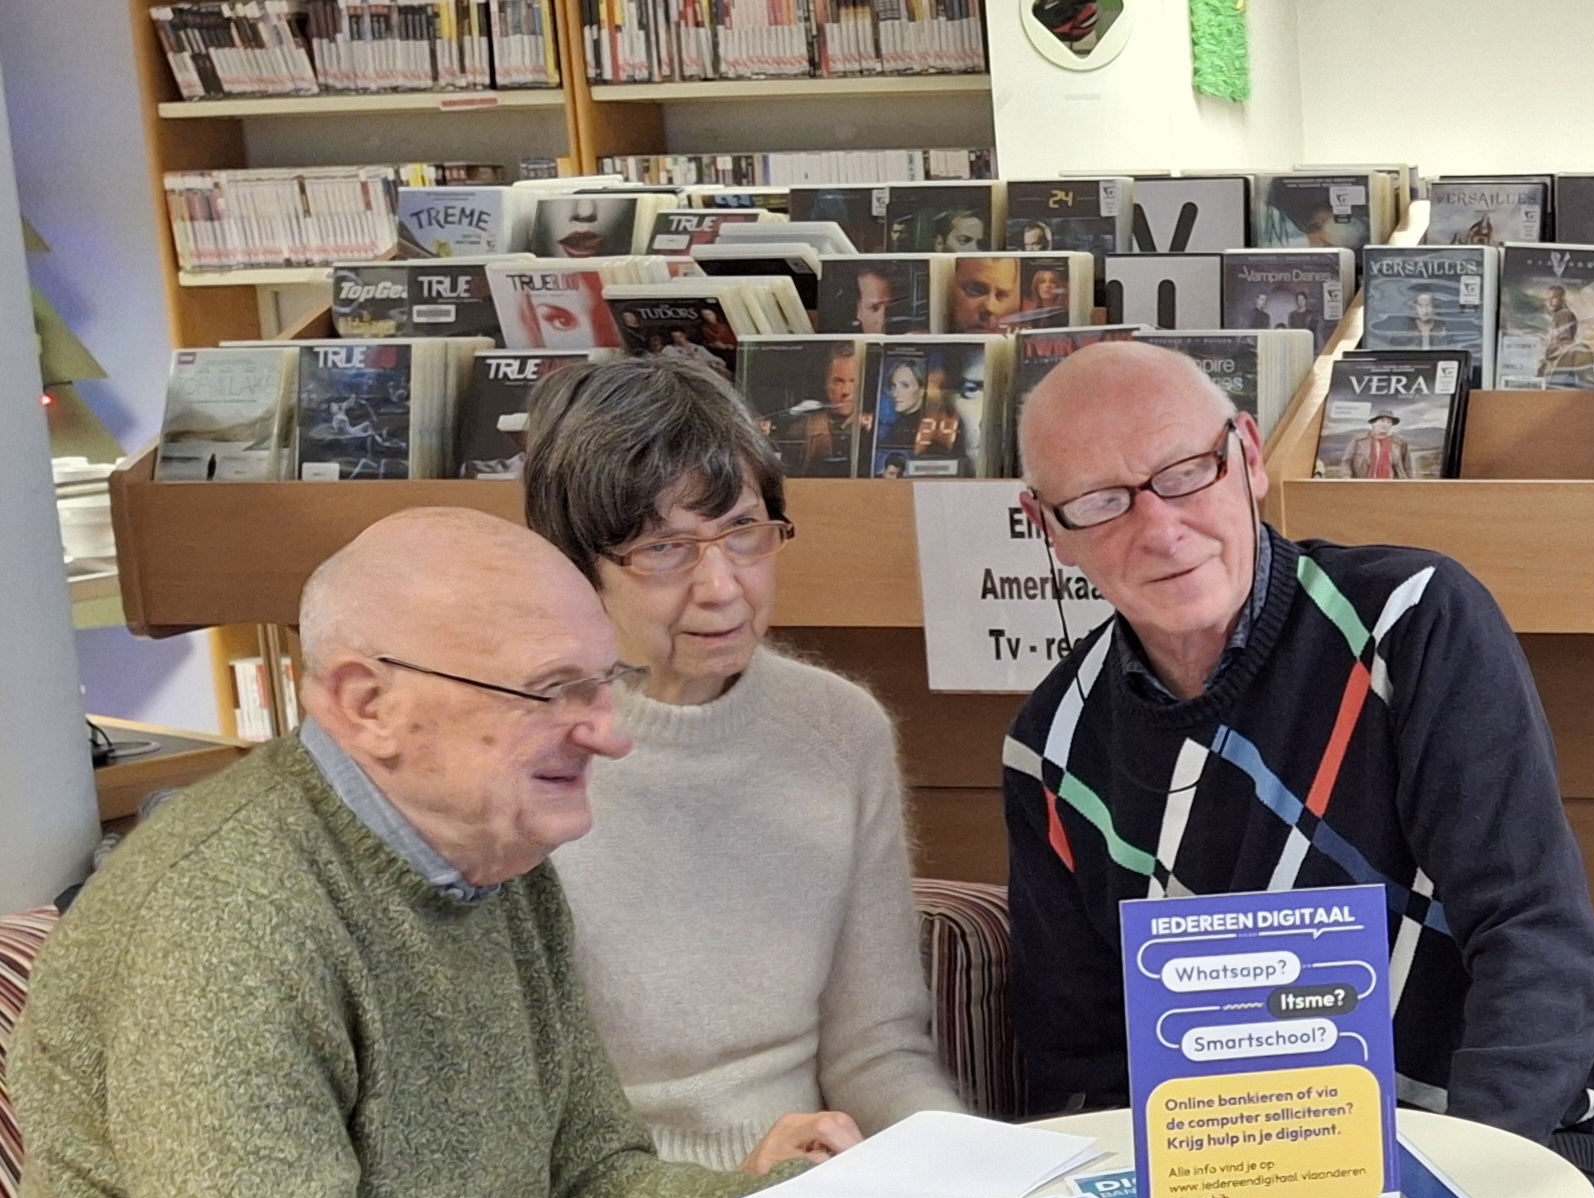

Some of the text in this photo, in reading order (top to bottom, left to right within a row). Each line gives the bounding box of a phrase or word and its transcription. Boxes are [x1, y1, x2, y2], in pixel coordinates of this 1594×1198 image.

[1049, 190, 1073, 208] 24
[409, 205, 491, 232] TREME
[669, 215, 718, 232] TRUE
[1370, 260, 1479, 279] VERSAILLES
[417, 275, 472, 298] TRUE
[505, 273, 551, 291] TRUE
[637, 307, 699, 320] TUDORS
[313, 346, 367, 368] TRUE
[486, 358, 541, 380] TRUE
[1349, 375, 1430, 395] VERA
[915, 417, 959, 447] 24
[981, 568, 1105, 600] Amerika
[989, 629, 1020, 660] Tv
[1151, 906, 1355, 936] IEDEREEN DIGITAAL
[1175, 959, 1288, 984] Whatsapp?
[1281, 989, 1345, 1011] Itsme?
[1193, 1027, 1327, 1053] Smartschool?
[1165, 1086, 1338, 1112] Online bankieren of via
[1166, 1102, 1354, 1131] de computer solliciteren?
[1167, 1123, 1342, 1151] Krijg hulp in je digipunt.
[1193, 1163, 1217, 1175] info
[1219, 1161, 1244, 1173] vind
[1246, 1160, 1257, 1174] je
[1259, 1160, 1275, 1172] op
